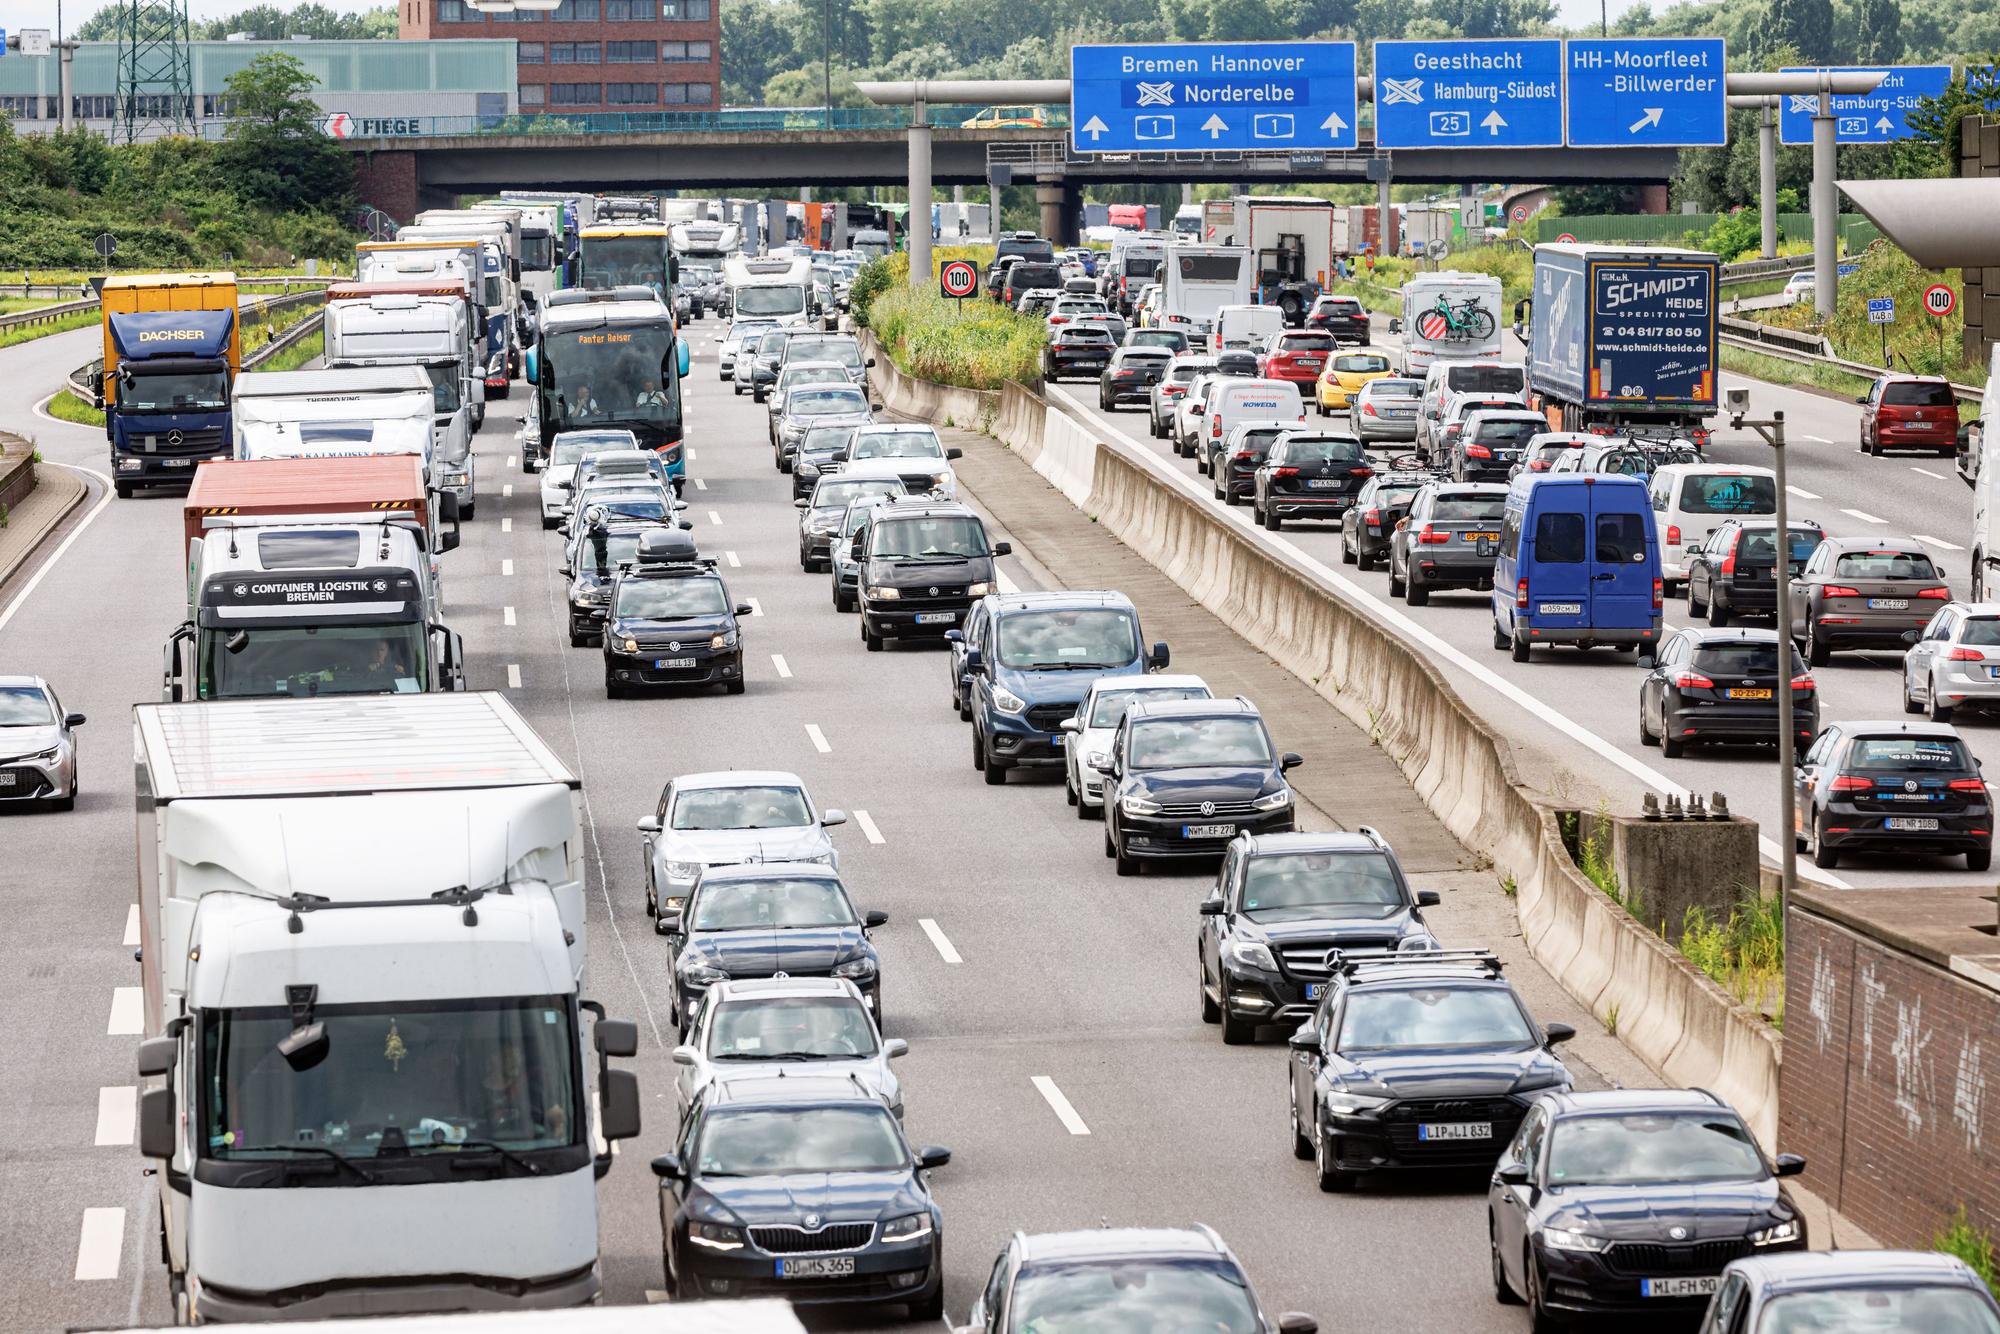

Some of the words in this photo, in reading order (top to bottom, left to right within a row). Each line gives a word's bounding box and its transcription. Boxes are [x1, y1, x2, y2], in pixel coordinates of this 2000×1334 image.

[1121, 56, 1199, 74] Bremen
[1211, 54, 1305, 72] Hannover
[1413, 52, 1523, 70] Geesthacht
[1574, 50, 1708, 69] HH-Moorfleet
[1604, 74, 1717, 93] -Billwerder
[1184, 84, 1295, 103] Norderelbe
[1434, 80, 1557, 104] Hamburg-Südost
[363, 119, 420, 135] FIEGE
[1151, 120, 1159, 135] 1
[1271, 118, 1279, 133] 1
[1440, 116, 1460, 131] 25
[1846, 120, 1860, 131] 25
[950, 271, 970, 288] 100
[1606, 275, 1700, 309] SCHMIDT
[1665, 297, 1704, 309] HEIDE
[1929, 292, 1950, 308] 100
[1619, 311, 1686, 319] SPEDITION
[139, 329, 205, 342] DACHSER
[1596, 343, 1708, 353] www.schmidt-heide.de
[252, 582, 315, 594] CONTAINER
[319, 581, 369, 592] LOGISTIK
[286, 591, 335, 602] BREMEN
[1208, 826, 1219, 834] EF
[1220, 825, 1235, 834] 270
[1470, 1124, 1490, 1137] 832
[828, 1258, 854, 1272] 365
[1654, 1281, 1670, 1293] MI
[1680, 1279, 1697, 1292] FH
